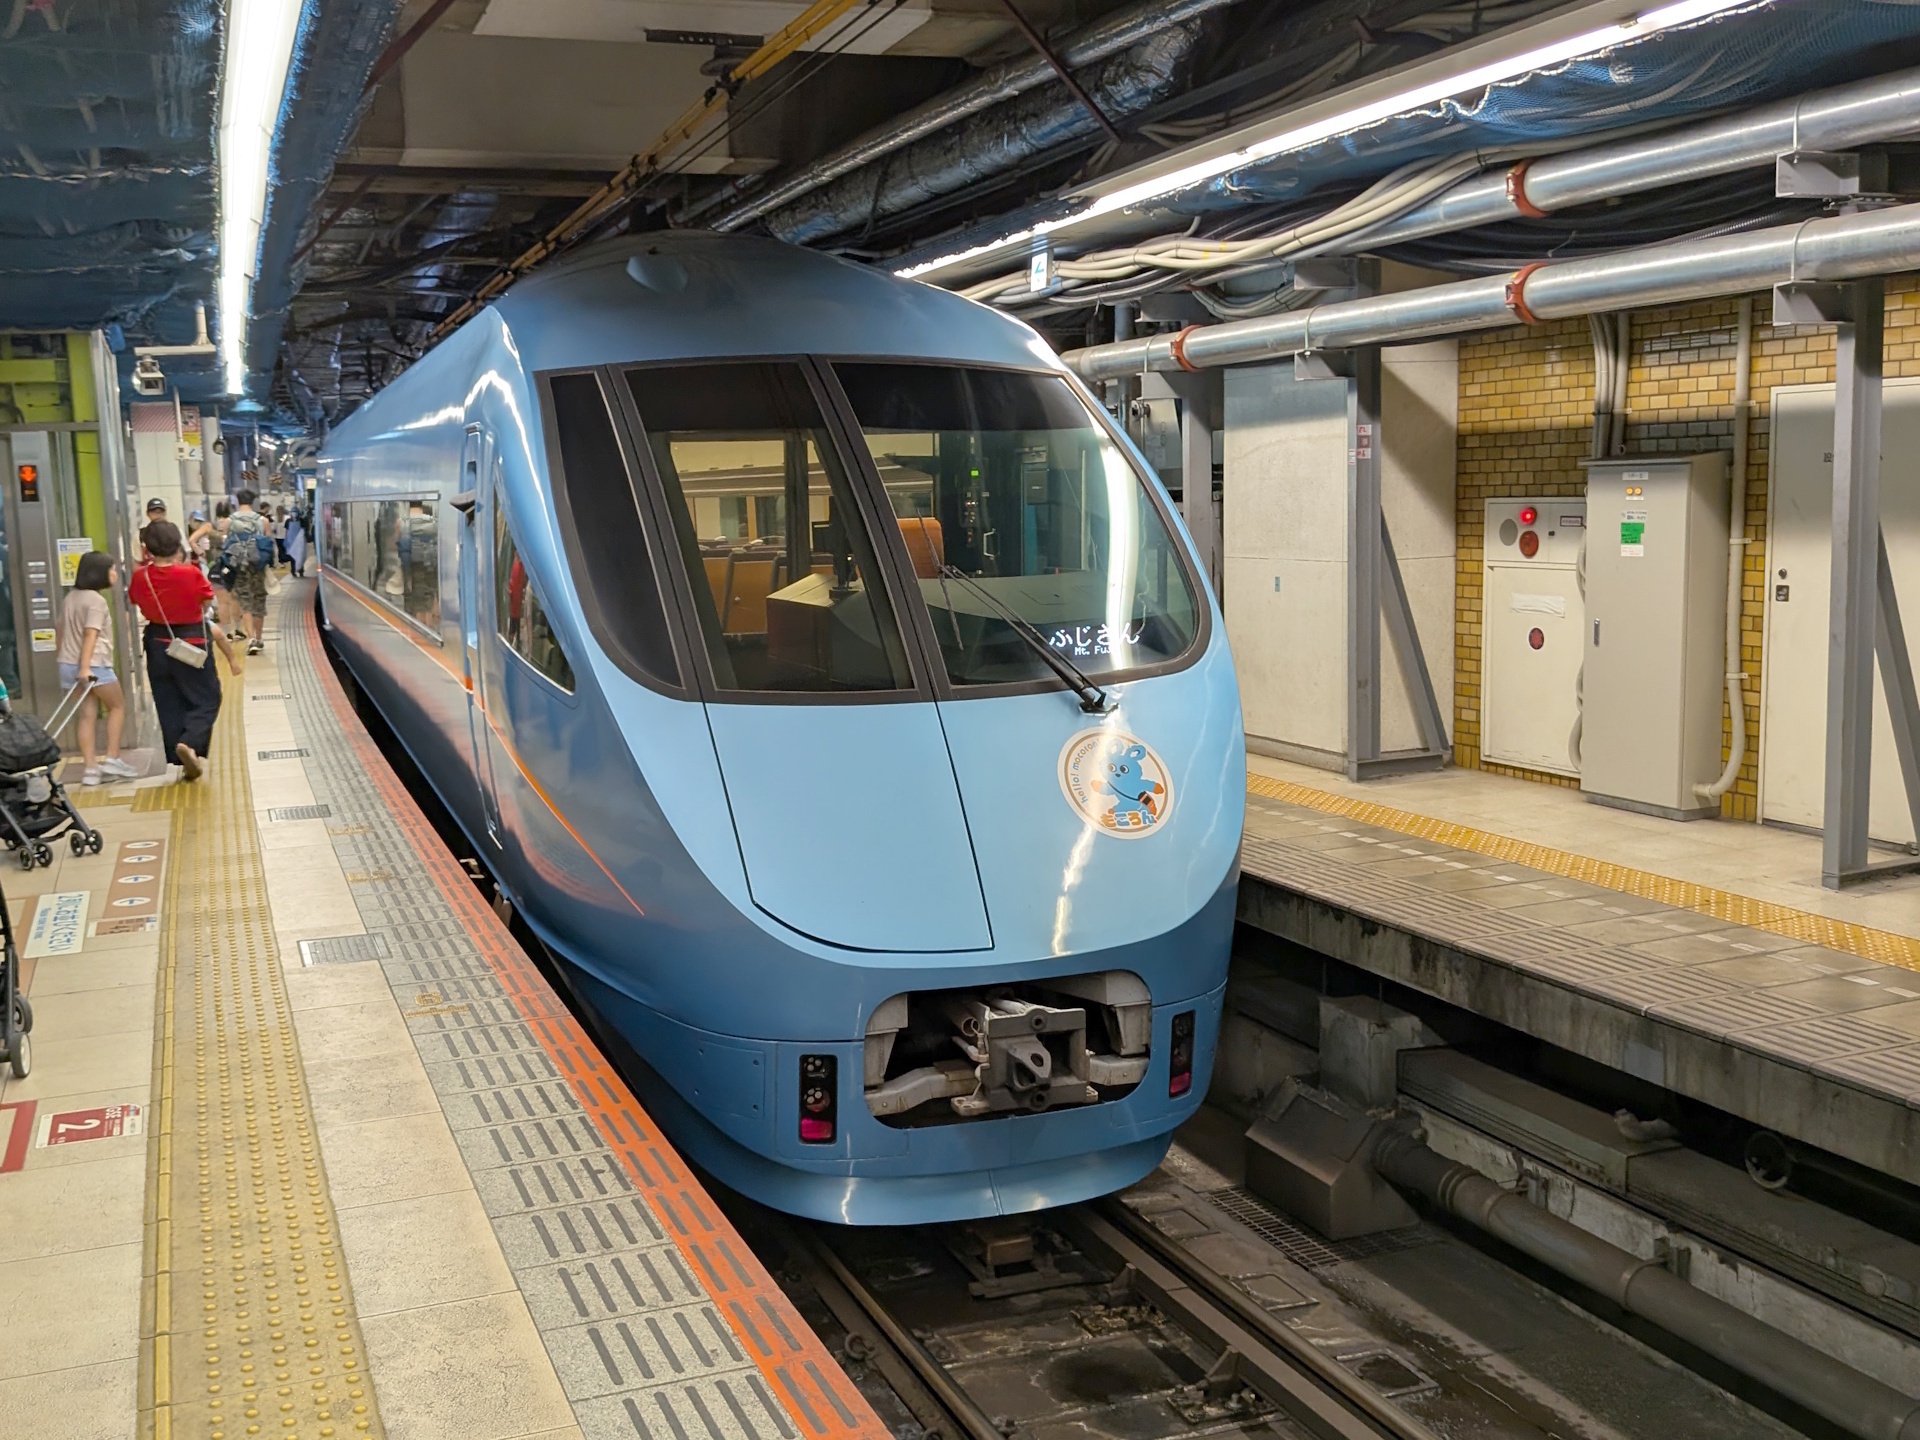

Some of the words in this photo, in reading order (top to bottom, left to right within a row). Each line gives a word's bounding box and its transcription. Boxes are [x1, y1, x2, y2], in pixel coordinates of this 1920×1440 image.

[1049, 623, 1140, 647] ふじさん
[1075, 647, 1090, 656] Mt.
[1101, 809, 1156, 828] もころん
[58, 1119, 101, 1133] 2
